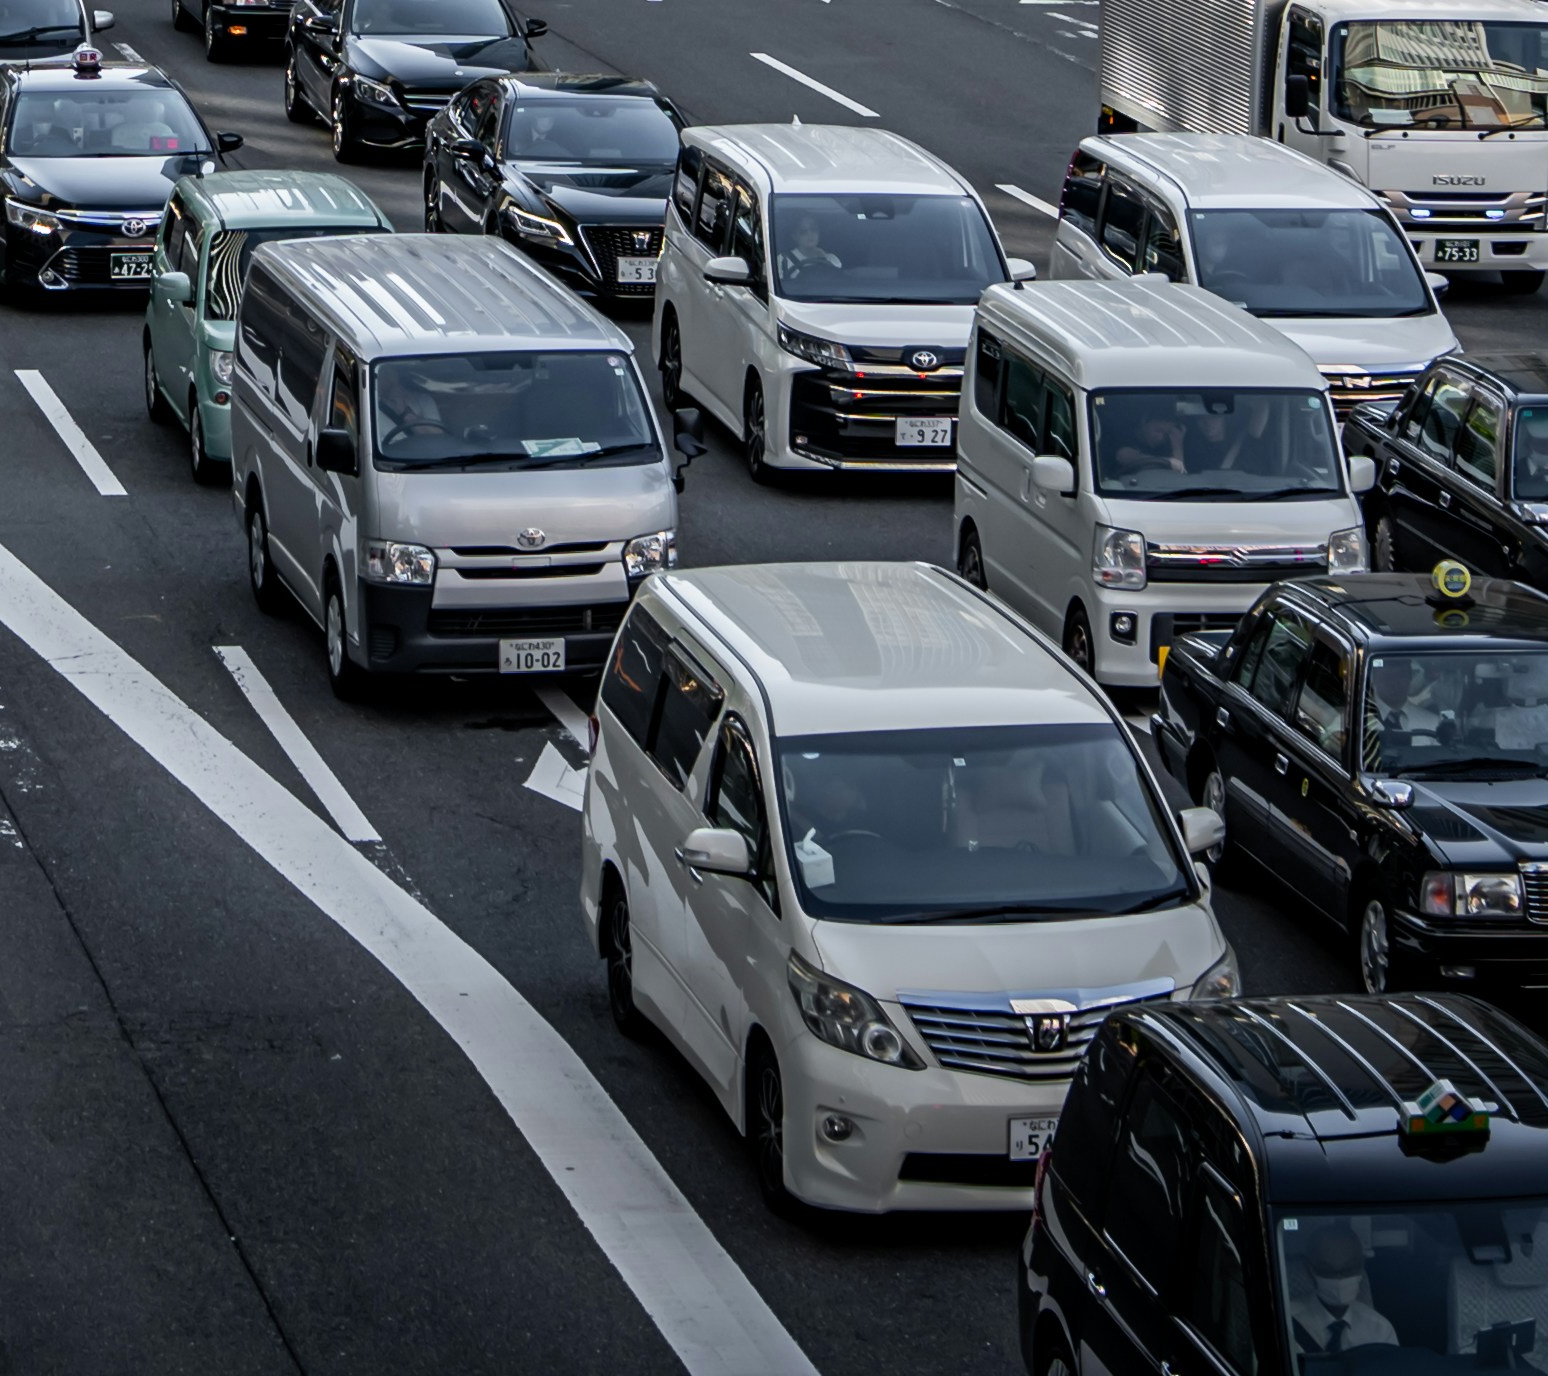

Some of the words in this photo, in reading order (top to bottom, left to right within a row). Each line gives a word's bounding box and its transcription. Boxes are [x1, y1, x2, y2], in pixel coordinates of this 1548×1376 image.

[1432, 174, 1486, 186] ISUZU
[1444, 247, 1478, 261] 75-33
[515, 641, 552, 651] なにわ430
[516, 651, 561, 669] 10-02
